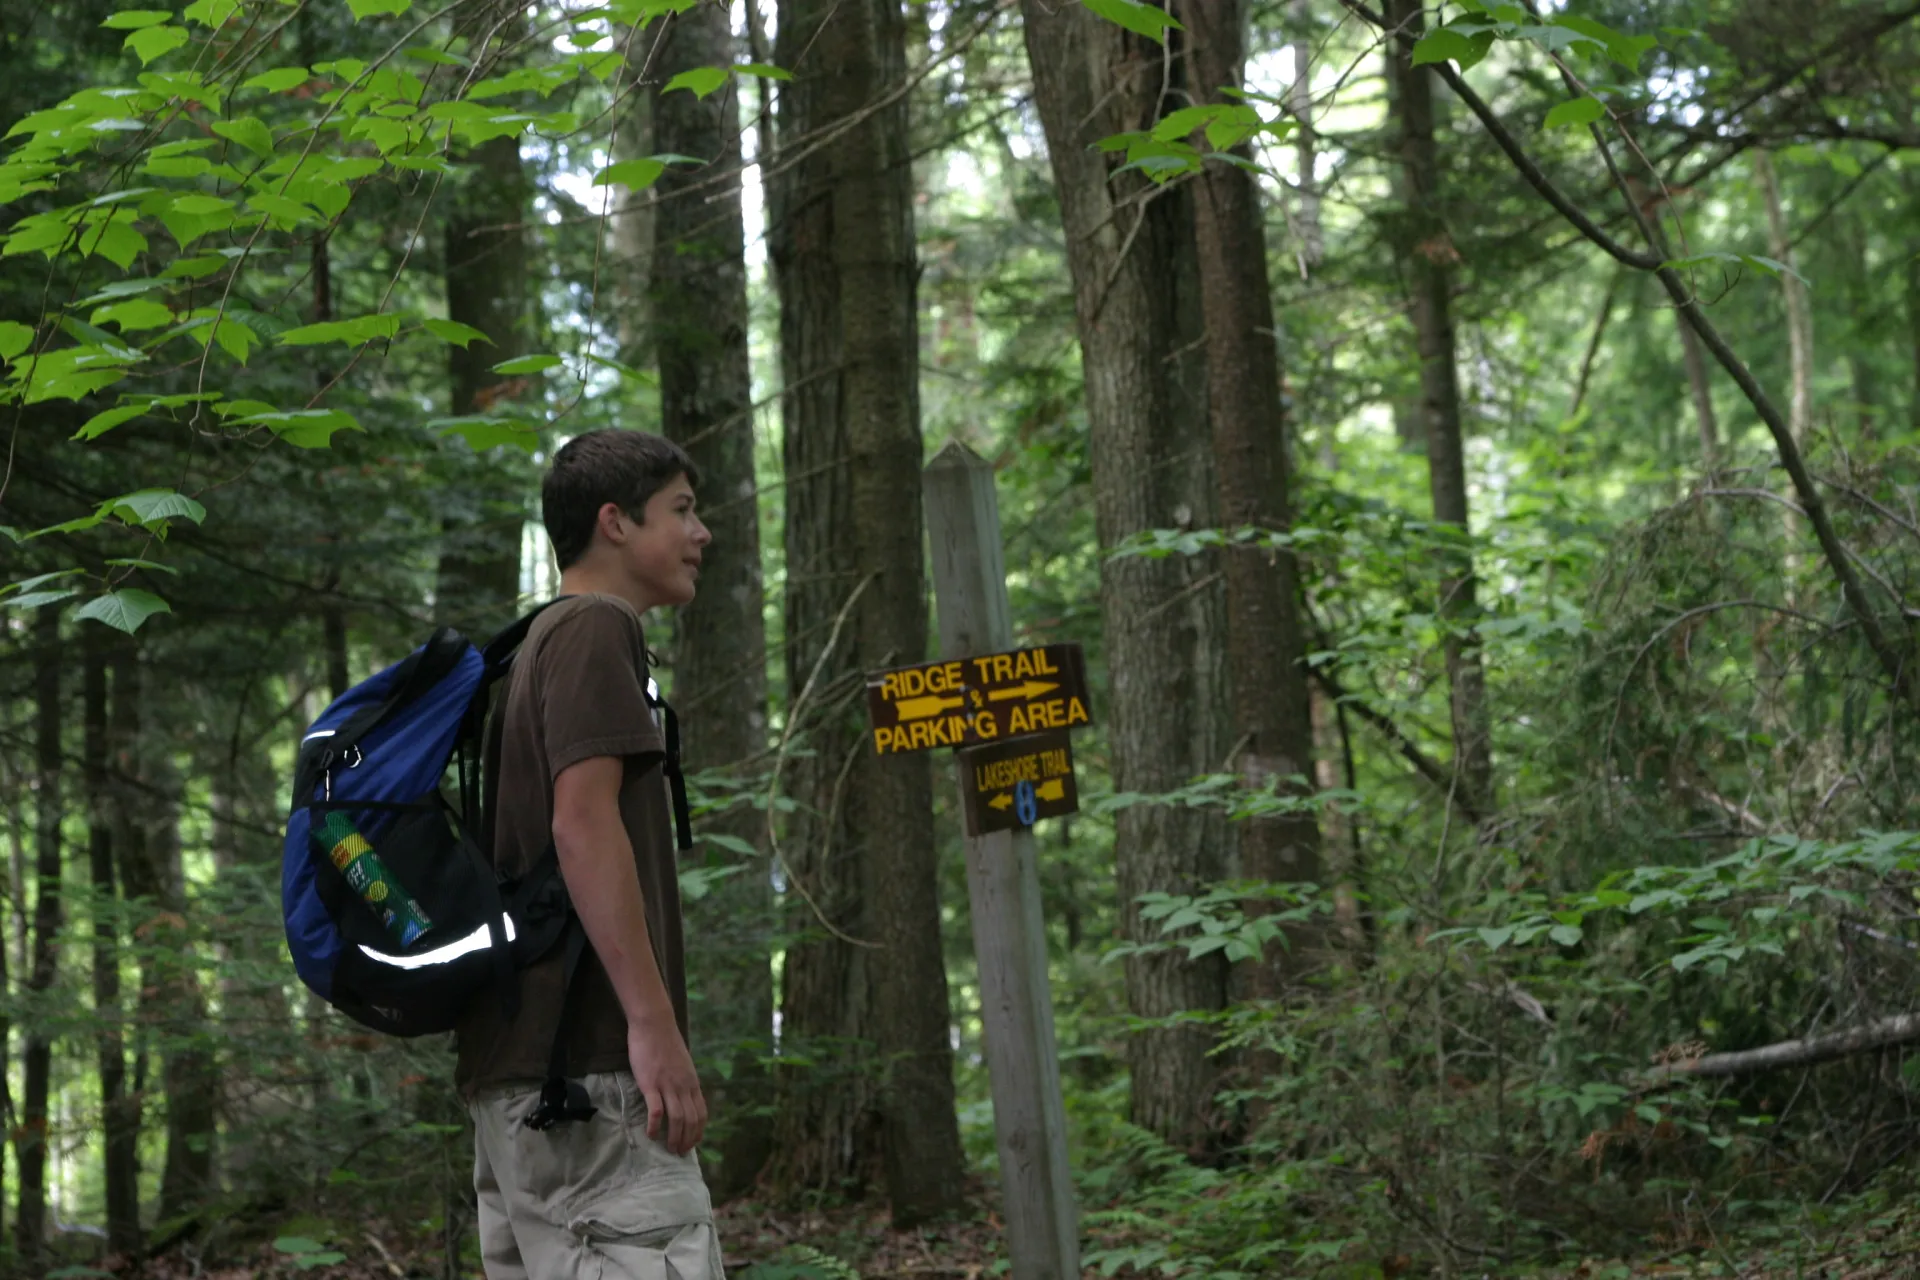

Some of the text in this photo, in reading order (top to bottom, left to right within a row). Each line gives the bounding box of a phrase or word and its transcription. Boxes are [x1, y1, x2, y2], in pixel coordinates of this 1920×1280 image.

[881, 648, 1058, 700] RIDGE TRAIL
[970, 689, 983, 708] &
[874, 696, 1088, 754] PARKING AREA
[976, 748, 1071, 792] LAKESHORE TRAIL
